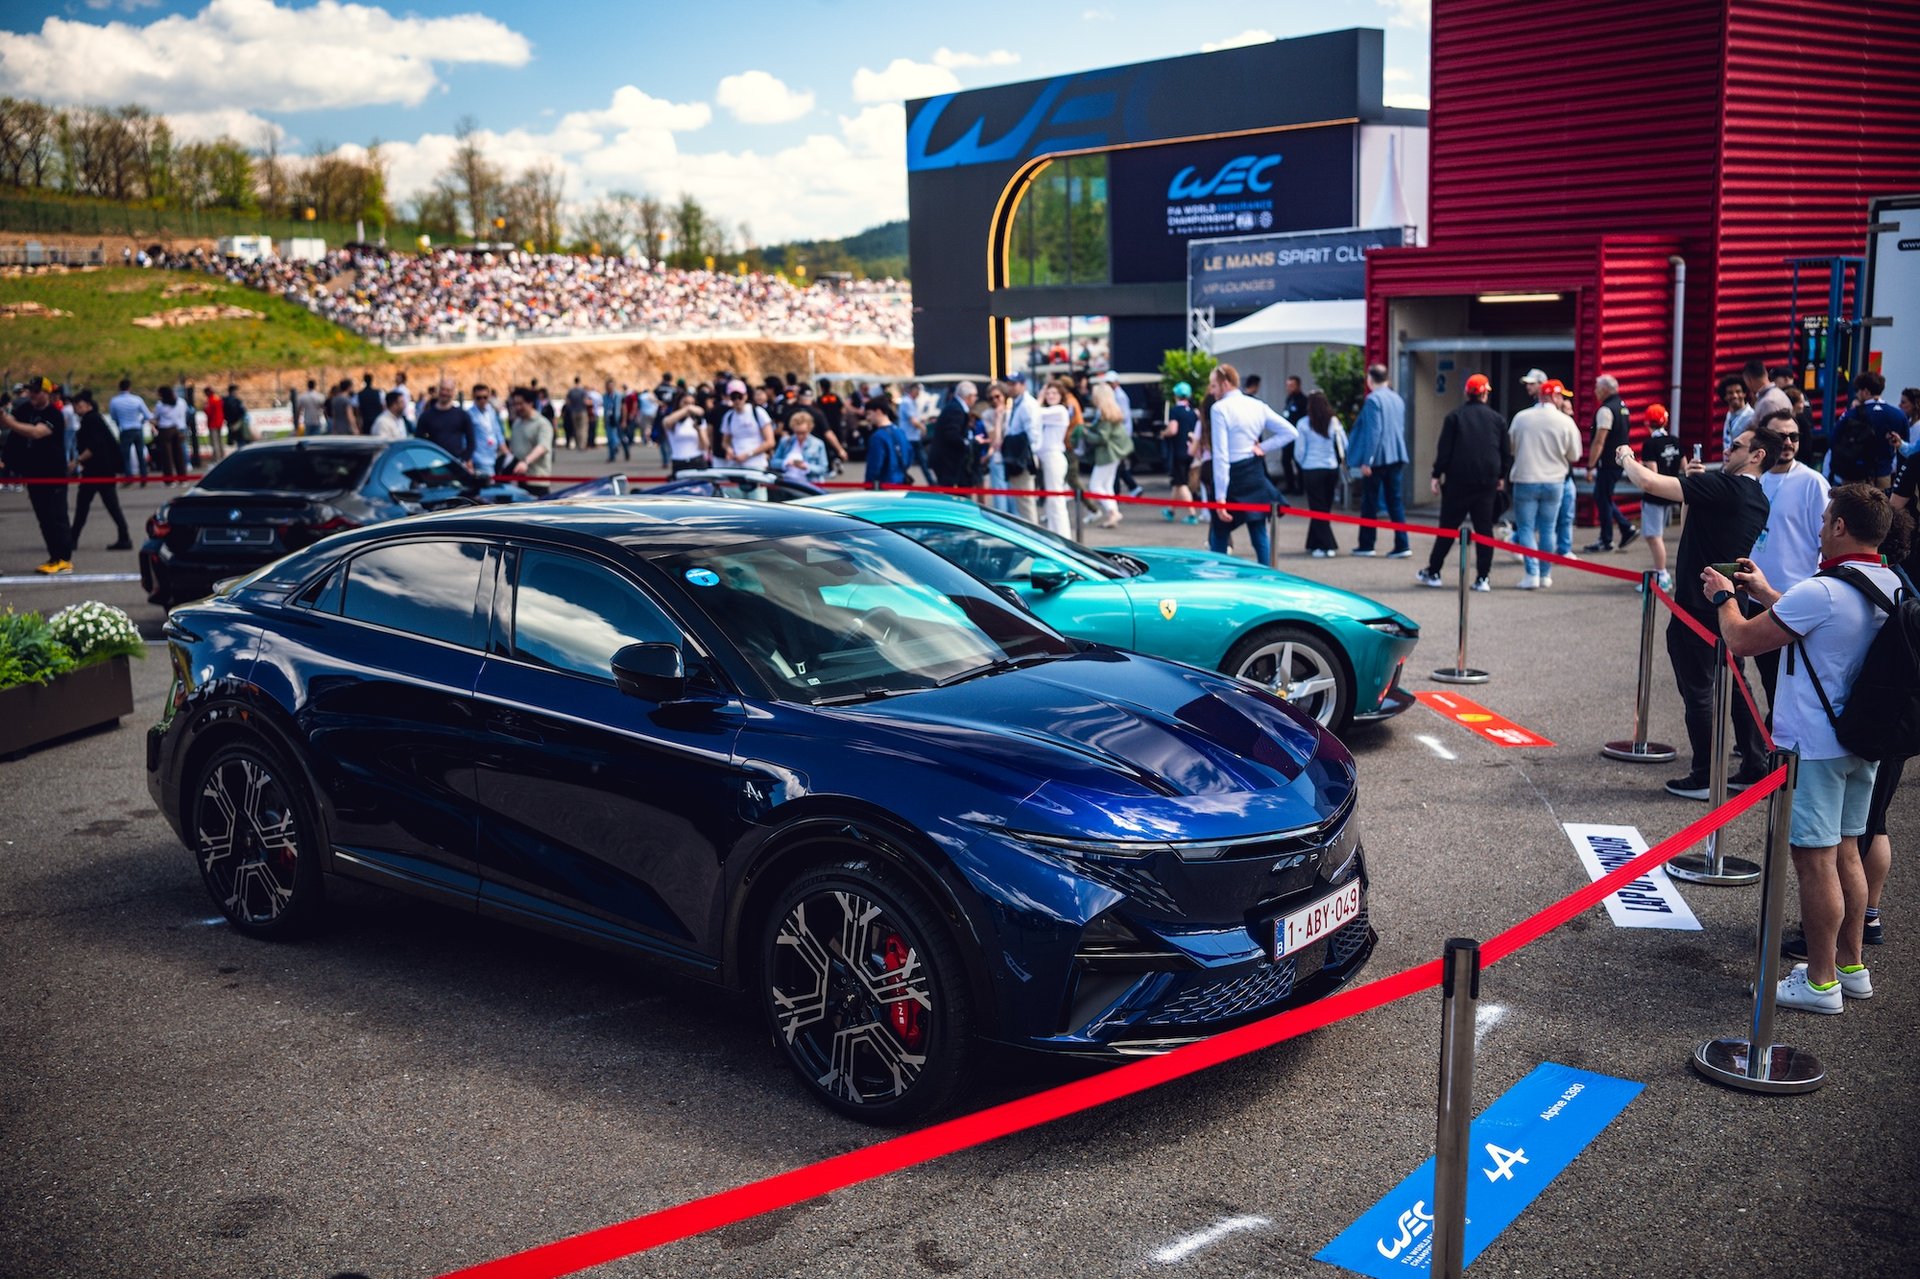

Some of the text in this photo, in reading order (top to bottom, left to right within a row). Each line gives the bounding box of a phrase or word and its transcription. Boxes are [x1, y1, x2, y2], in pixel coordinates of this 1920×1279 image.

[1167, 153, 1282, 200] WEC
[1183, 203, 1216, 214] WORLD
[1203, 256, 1222, 271] LE
[1226, 252, 1275, 268] MANS
[1277, 247, 1331, 266] SPIRIT
[1288, 888, 1357, 946] 1-ABY-049
[1540, 1083, 1585, 1121] Alpine A390
[1377, 1200, 1434, 1260] WEC
